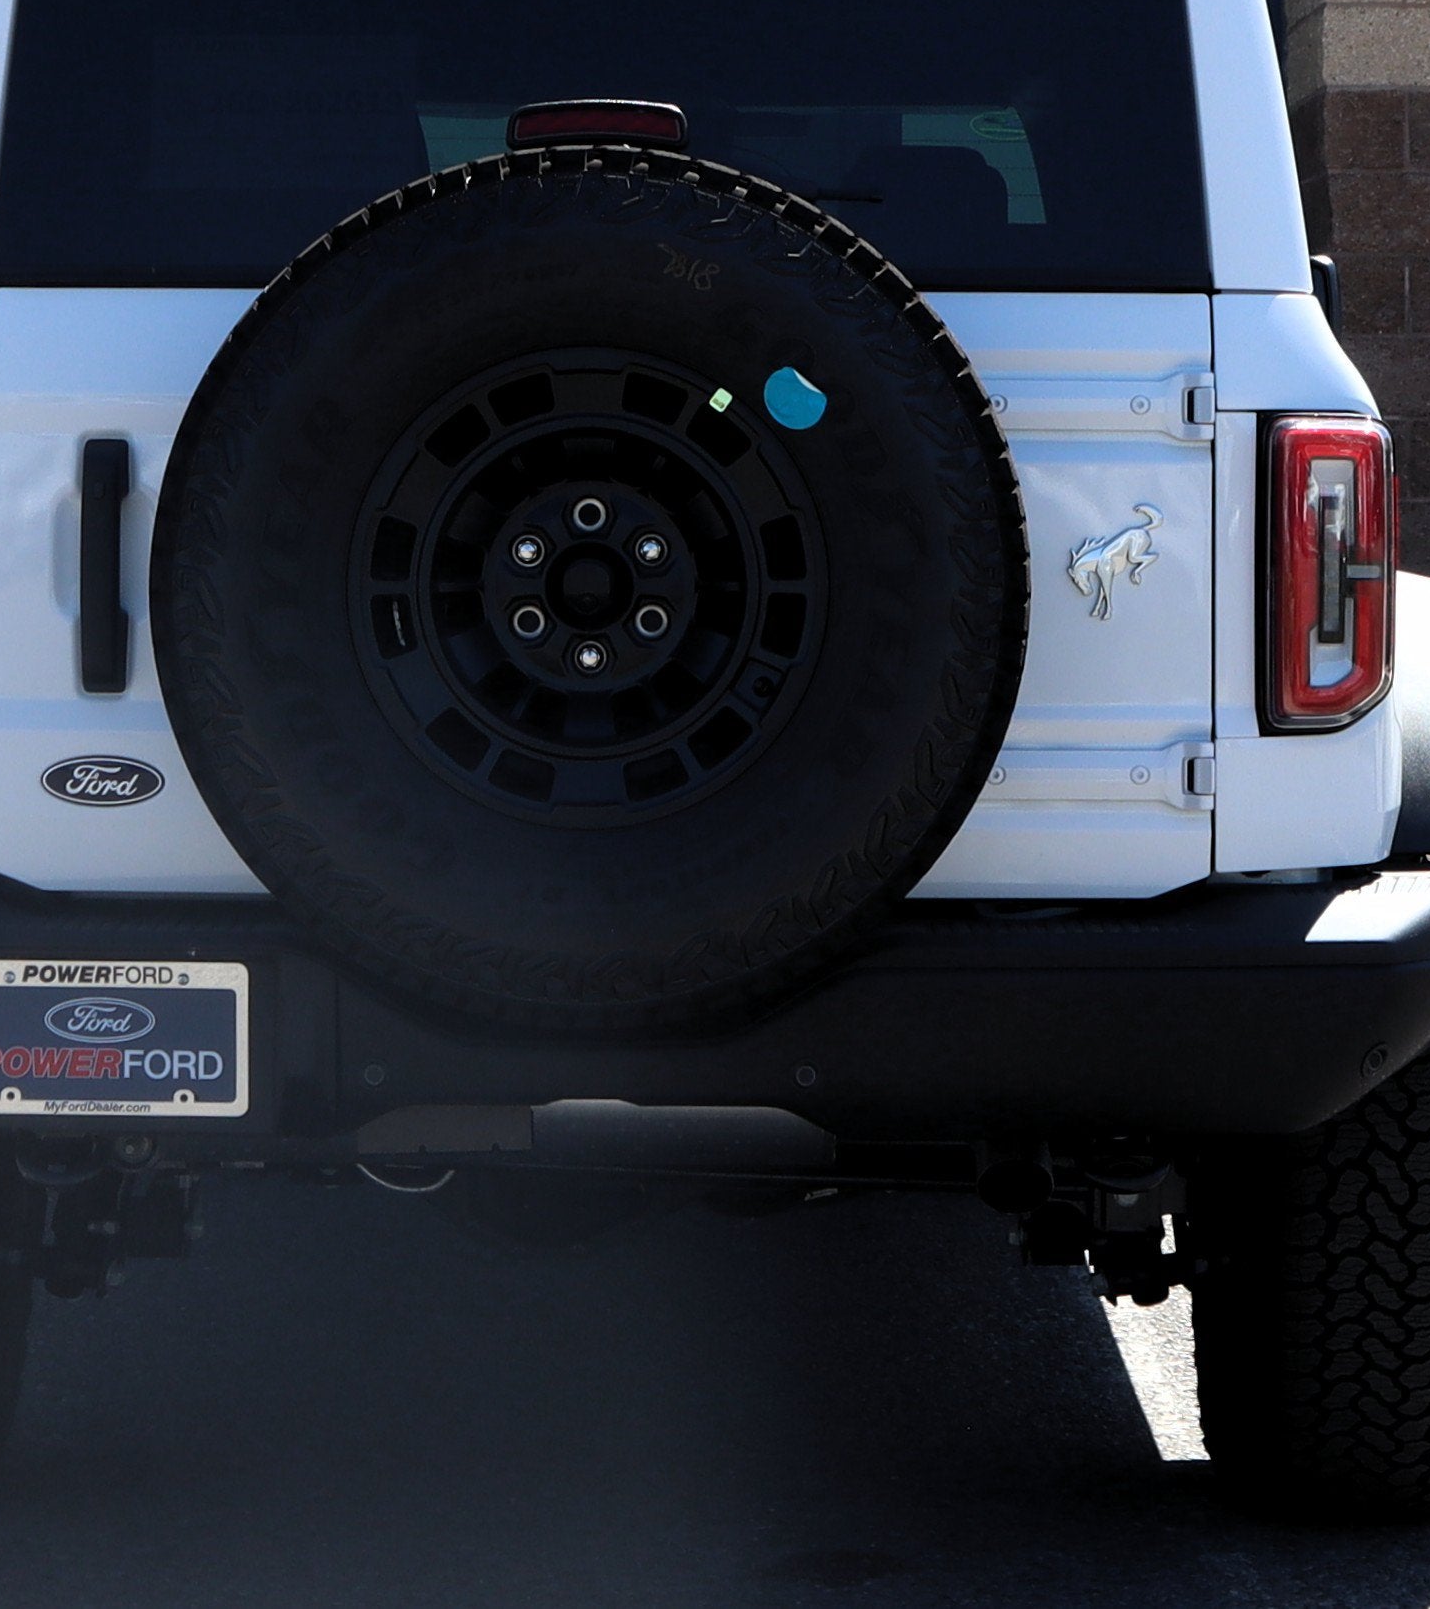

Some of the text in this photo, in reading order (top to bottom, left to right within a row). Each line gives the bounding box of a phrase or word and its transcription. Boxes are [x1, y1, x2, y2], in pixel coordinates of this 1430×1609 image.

[64, 764, 140, 797] Ford
[21, 964, 174, 985] POWERFORD
[66, 1004, 133, 1033] Ford
[43, 1100, 151, 1115] MyFordDealer.com
